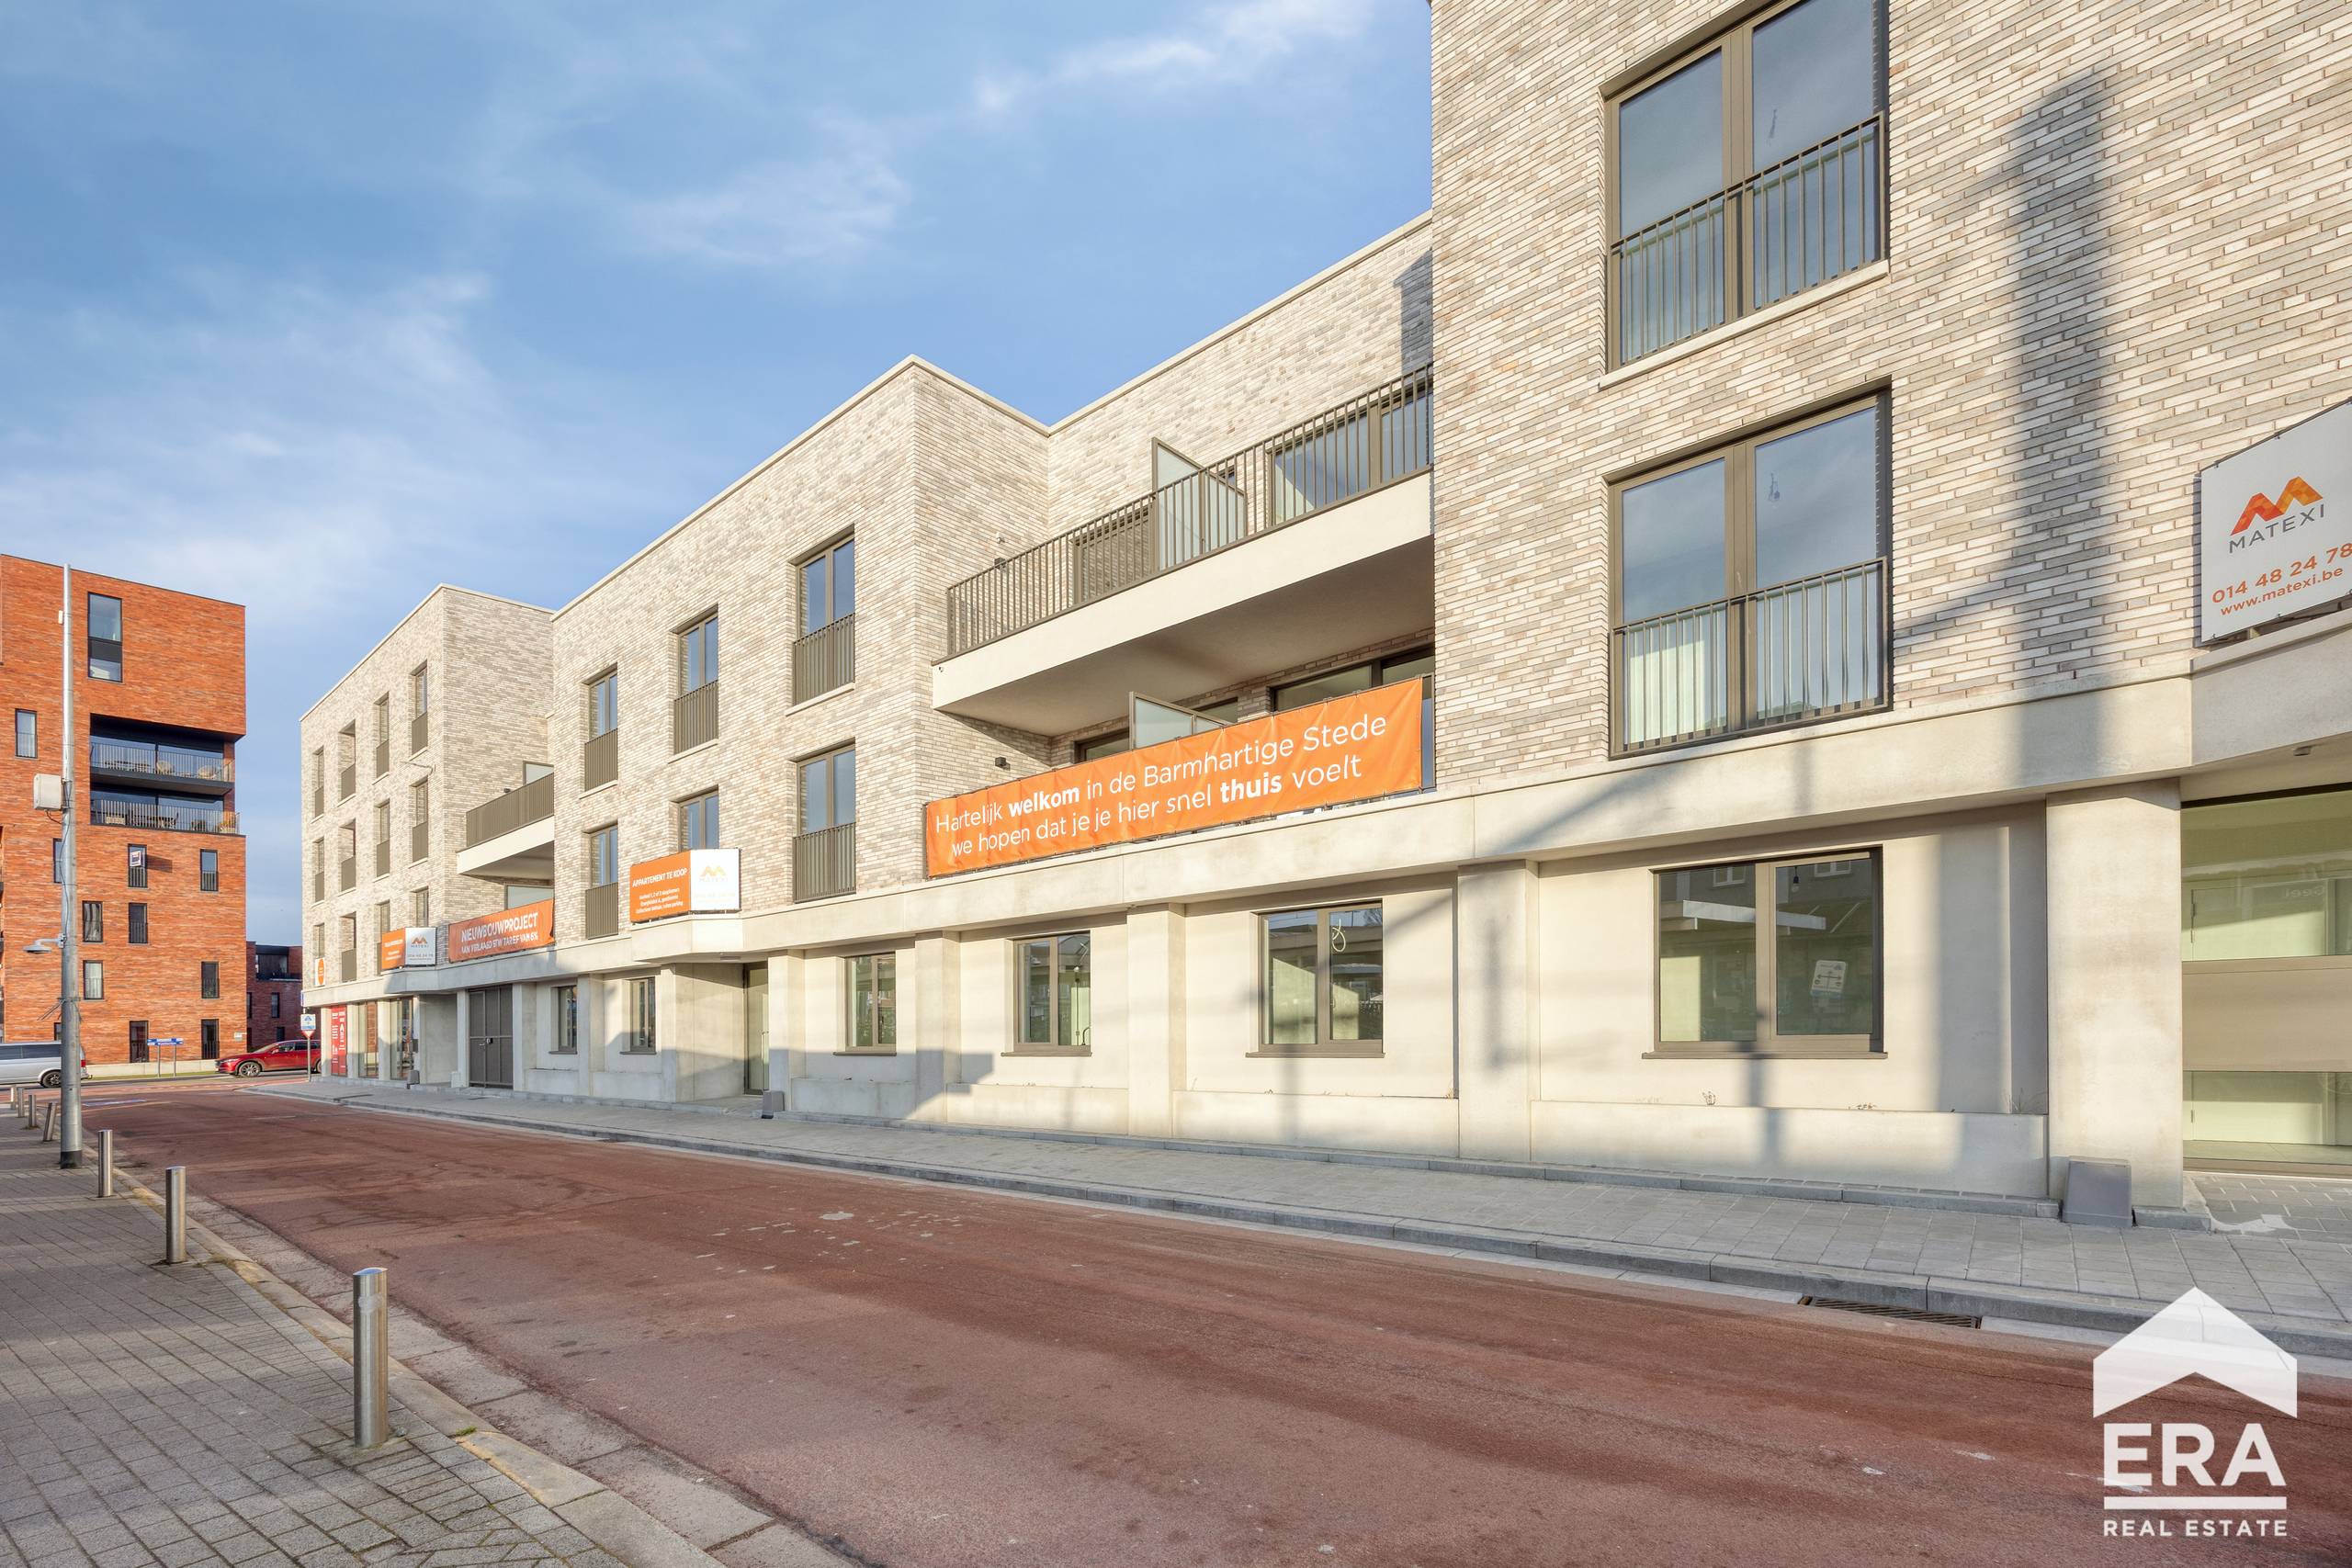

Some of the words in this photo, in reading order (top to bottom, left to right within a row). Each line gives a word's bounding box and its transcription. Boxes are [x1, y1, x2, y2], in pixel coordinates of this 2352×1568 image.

[2228, 504, 2324, 554] MATEXI
[2211, 581, 2248, 604] 014
[2256, 569, 2282, 587] 48
[2290, 555, 2317, 577] 24
[2326, 543, 2352, 564] 78
[2220, 568, 2343, 616] www.matexi.be
[935, 800, 1003, 834] Hartelijk
[1008, 786, 1080, 818] welkom
[1087, 779, 1102, 801] in
[1109, 772, 1136, 795] de
[1144, 738, 1294, 787] Barmhartige
[1303, 714, 1386, 751] Stede
[952, 840, 973, 857] we
[978, 828, 1030, 852] hopen
[1035, 816, 1067, 840] dat
[1071, 812, 1091, 837] je
[1094, 807, 1112, 832] je
[1118, 799, 1159, 824] hier
[1166, 784, 1212, 814] snel
[1219, 771, 1283, 805] thuis
[1291, 753, 1363, 790] voelt
[632, 873, 667, 888] APPARTEMENT
[666, 872, 673, 880] TE
[673, 867, 688, 878] KOOP
[461, 912, 538, 942] NIEUWBOUWPROJECT
